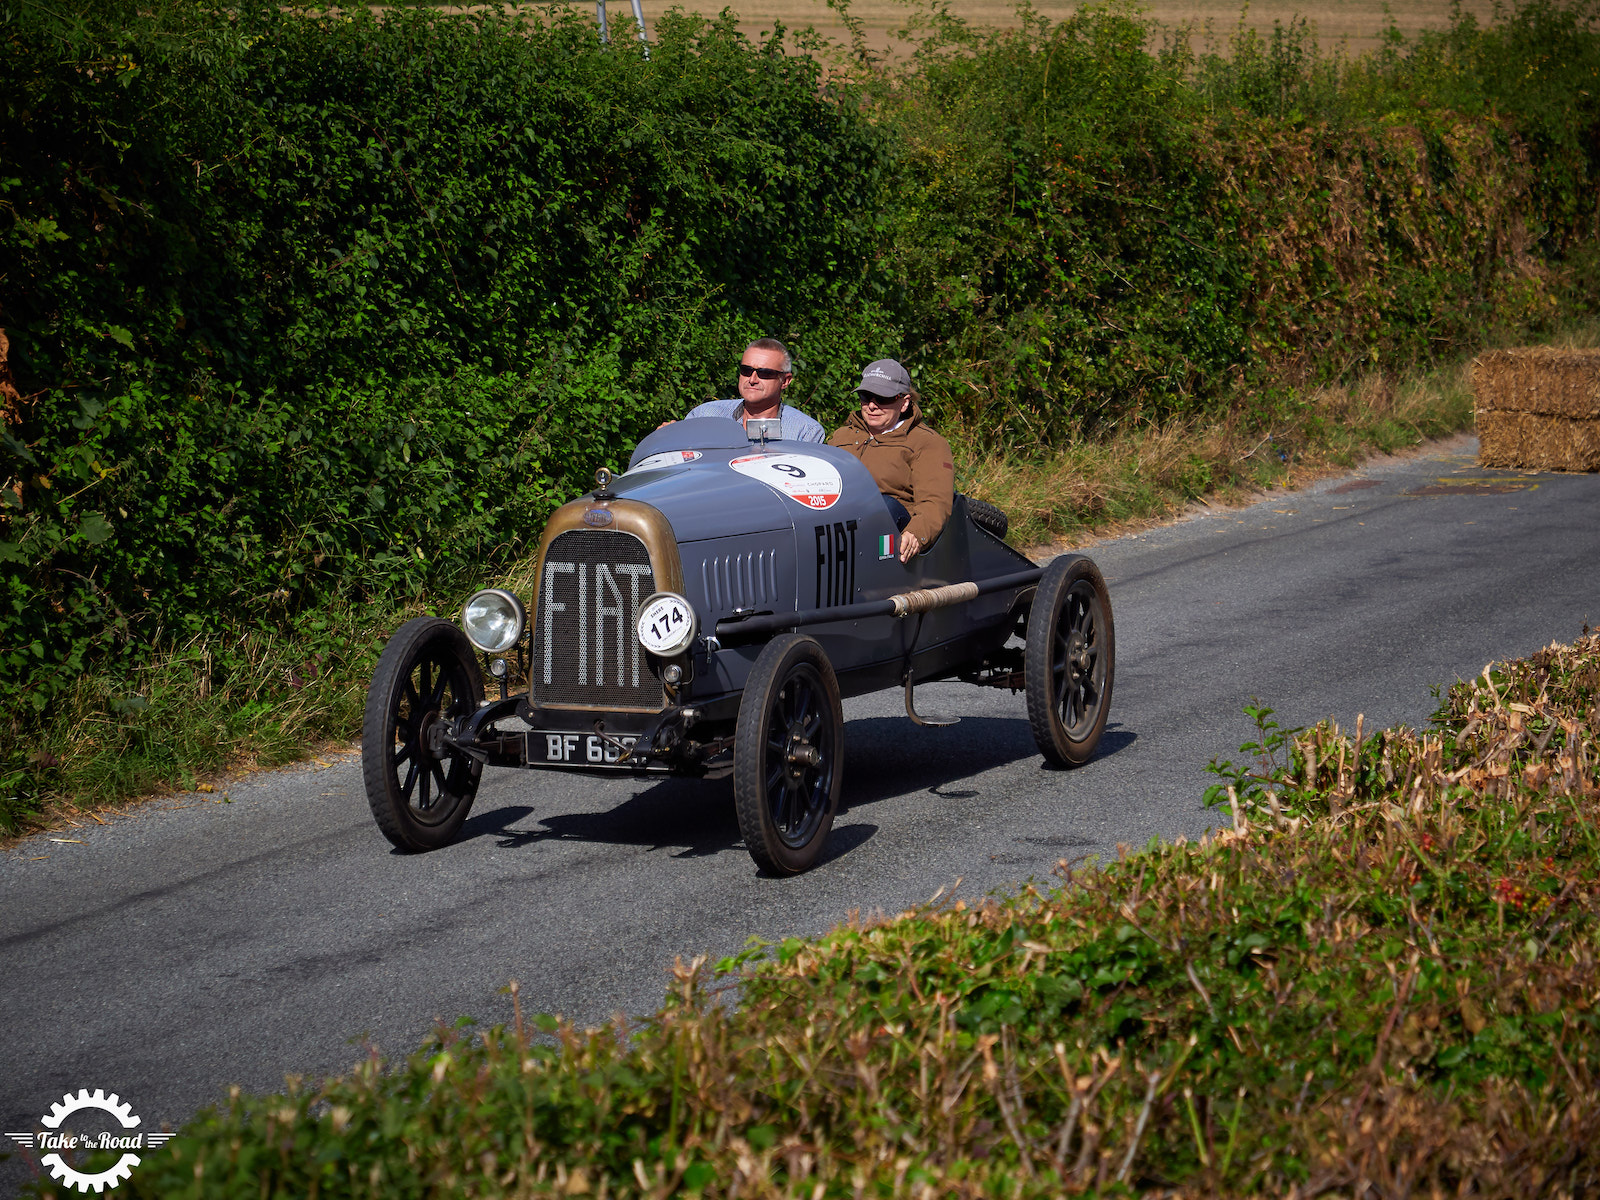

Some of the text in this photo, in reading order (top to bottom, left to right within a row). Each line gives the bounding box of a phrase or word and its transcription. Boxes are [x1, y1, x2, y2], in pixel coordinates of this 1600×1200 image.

[771, 464, 806, 478] 9
[808, 495, 827, 507] 2015
[814, 520, 858, 609] FIAT
[543, 561, 652, 687] FIAT
[651, 606, 683, 640] 174
[546, 734, 580, 761] BF
